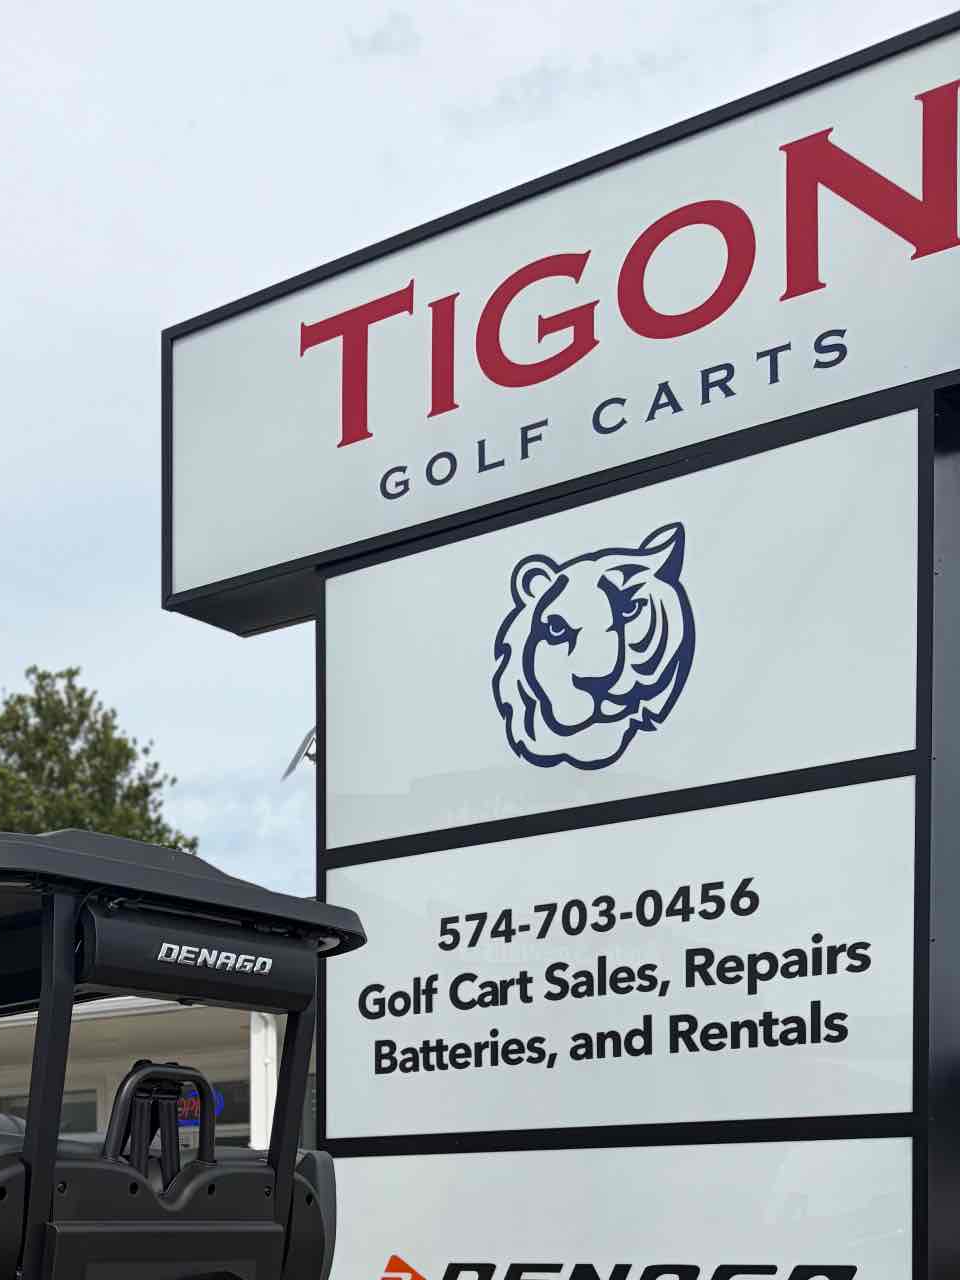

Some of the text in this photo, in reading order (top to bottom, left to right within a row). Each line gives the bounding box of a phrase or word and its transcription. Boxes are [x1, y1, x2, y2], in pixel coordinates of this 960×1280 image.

[300, 80, 960, 448] TIGON
[379, 328, 849, 501] GOLF CARTS
[437, 876, 761, 953] 574-703-0456
[157, 942, 273, 976] DENAGO
[358, 932, 872, 1020] Golf Cart Sales, Repairs
[374, 999, 849, 1075] Batteries, and Rentals
